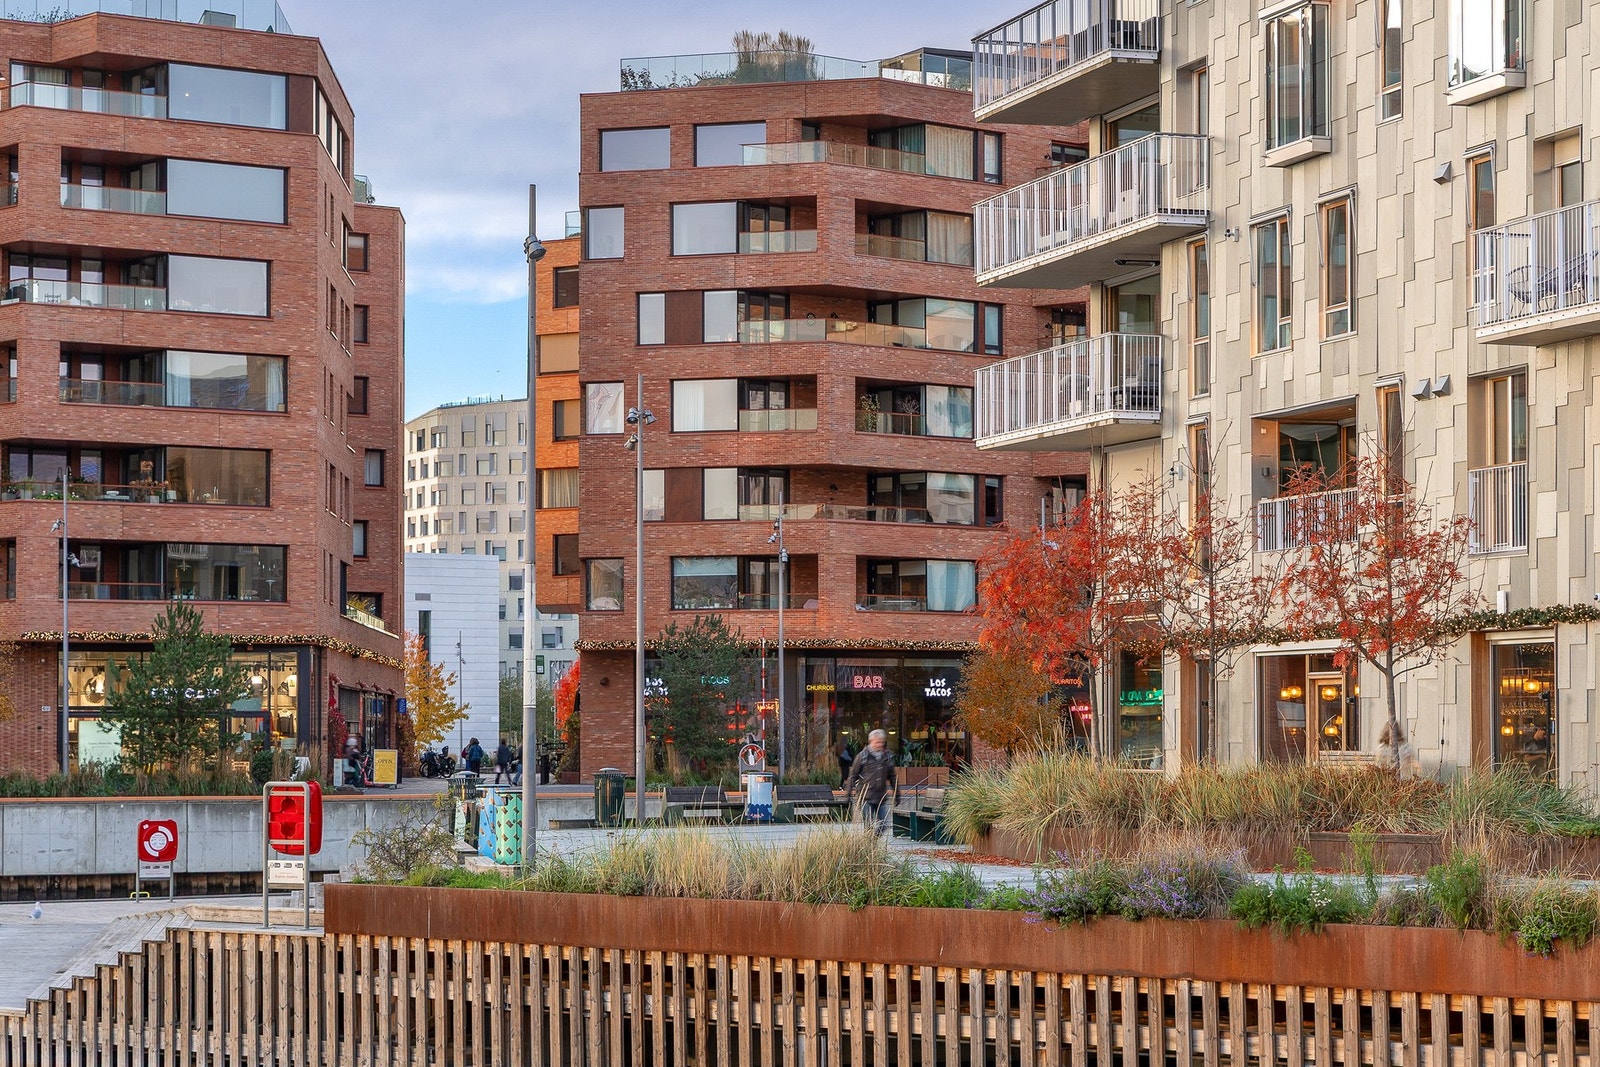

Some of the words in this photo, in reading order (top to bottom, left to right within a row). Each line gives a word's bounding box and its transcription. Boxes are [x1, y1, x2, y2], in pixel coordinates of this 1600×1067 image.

[853, 675, 883, 689] BAR
[929, 678, 946, 688] LOS
[806, 684, 835, 692] CHURROS
[924, 687, 952, 697] TACOS
